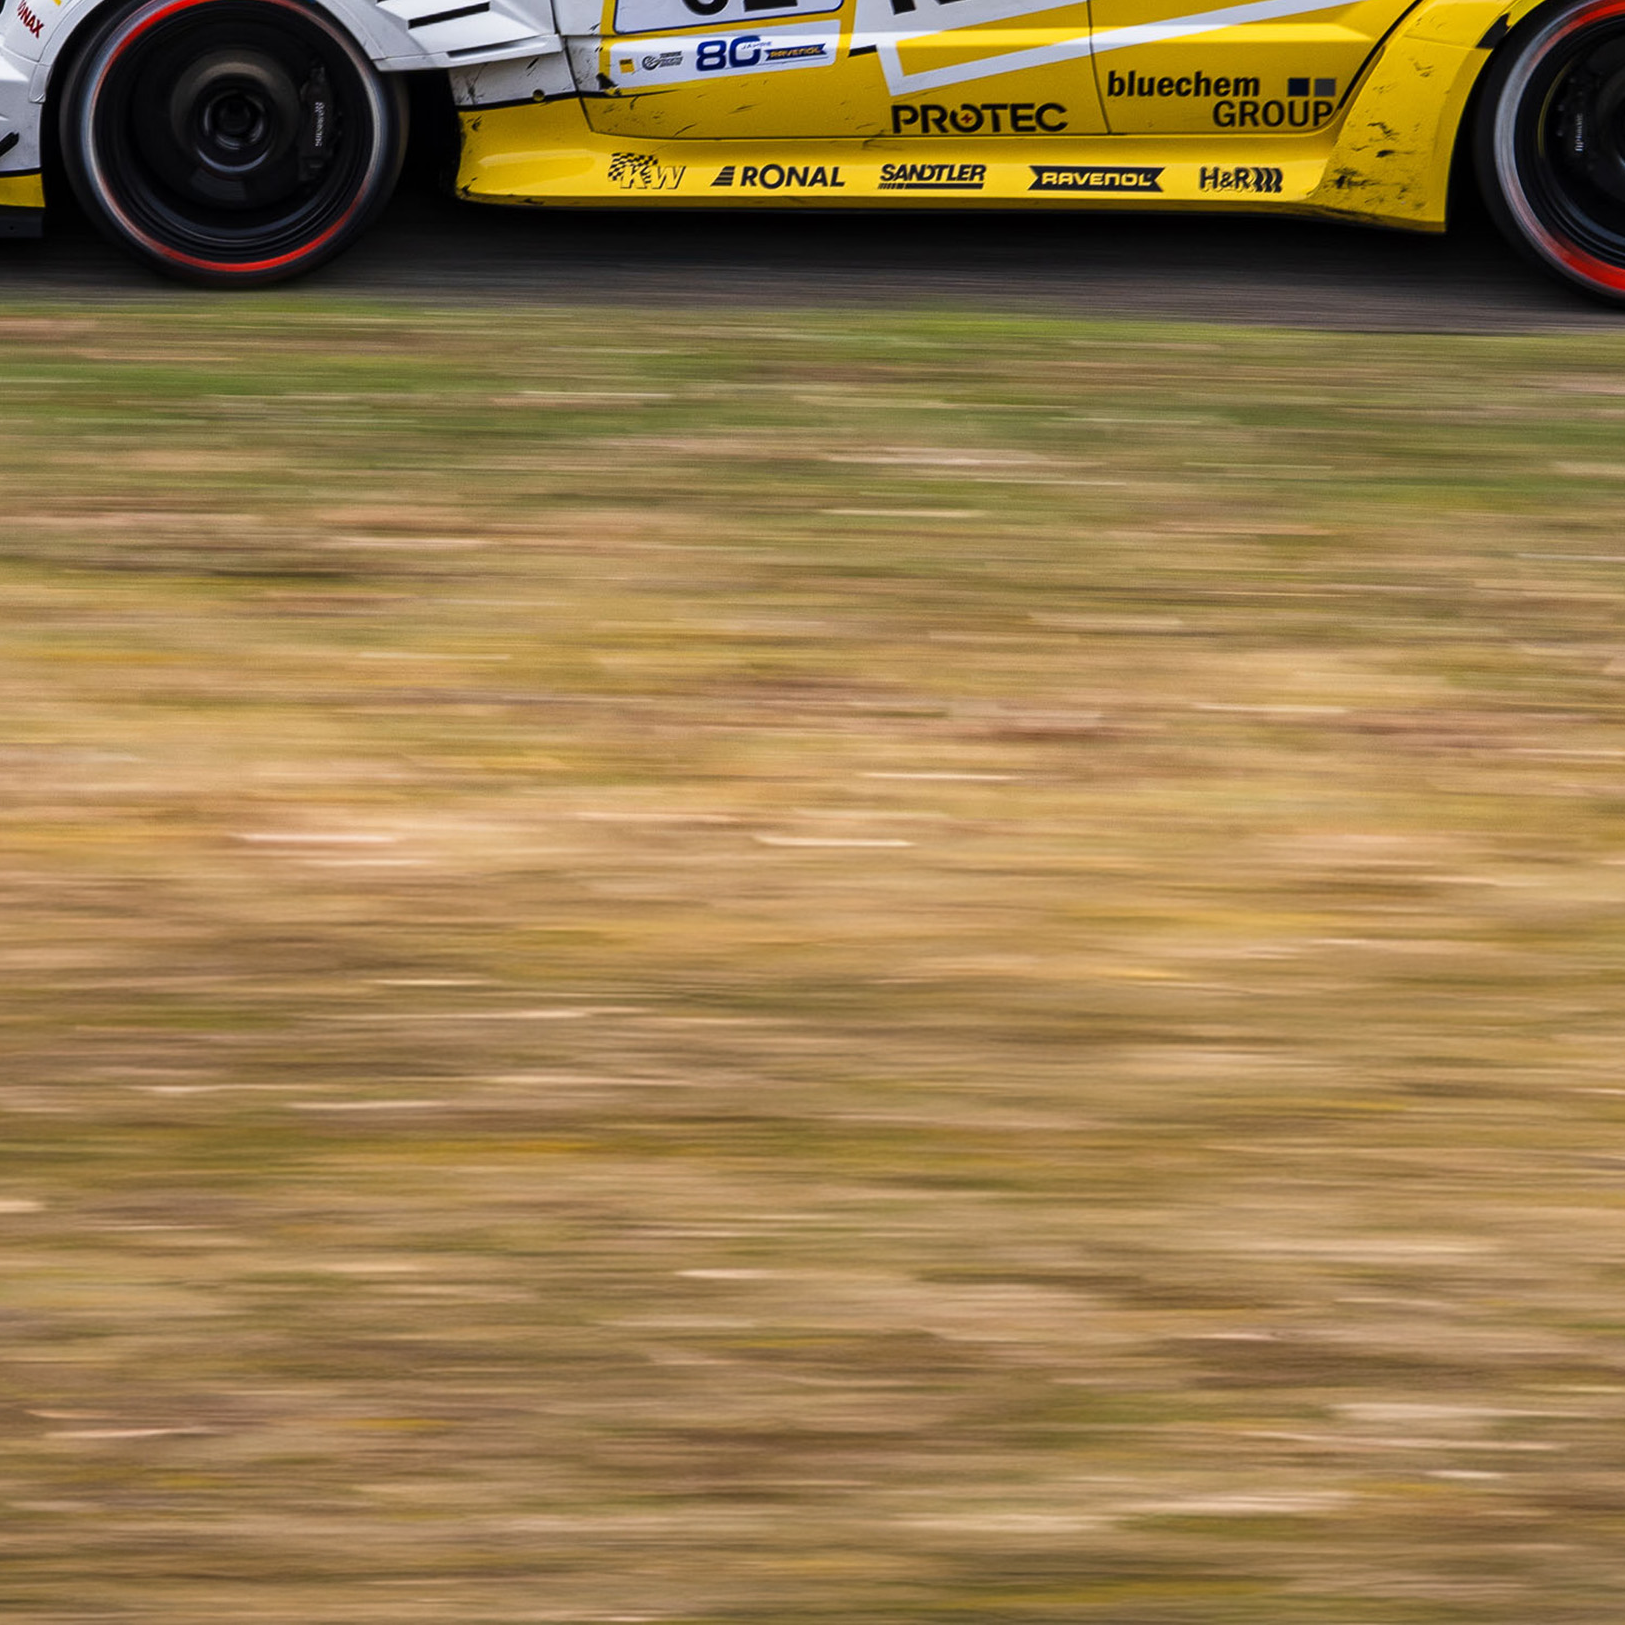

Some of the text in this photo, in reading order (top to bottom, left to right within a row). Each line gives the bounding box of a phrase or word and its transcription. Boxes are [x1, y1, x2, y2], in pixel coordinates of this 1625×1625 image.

[1107, 71, 1260, 99] bluechem
[891, 102, 1070, 134] PROTEC
[1212, 100, 1335, 128] GROUP
[620, 165, 686, 189] KW
[740, 163, 846, 190] RONAL
[879, 163, 988, 183] SANDTLER
[1041, 171, 1154, 187] RAVENOL
